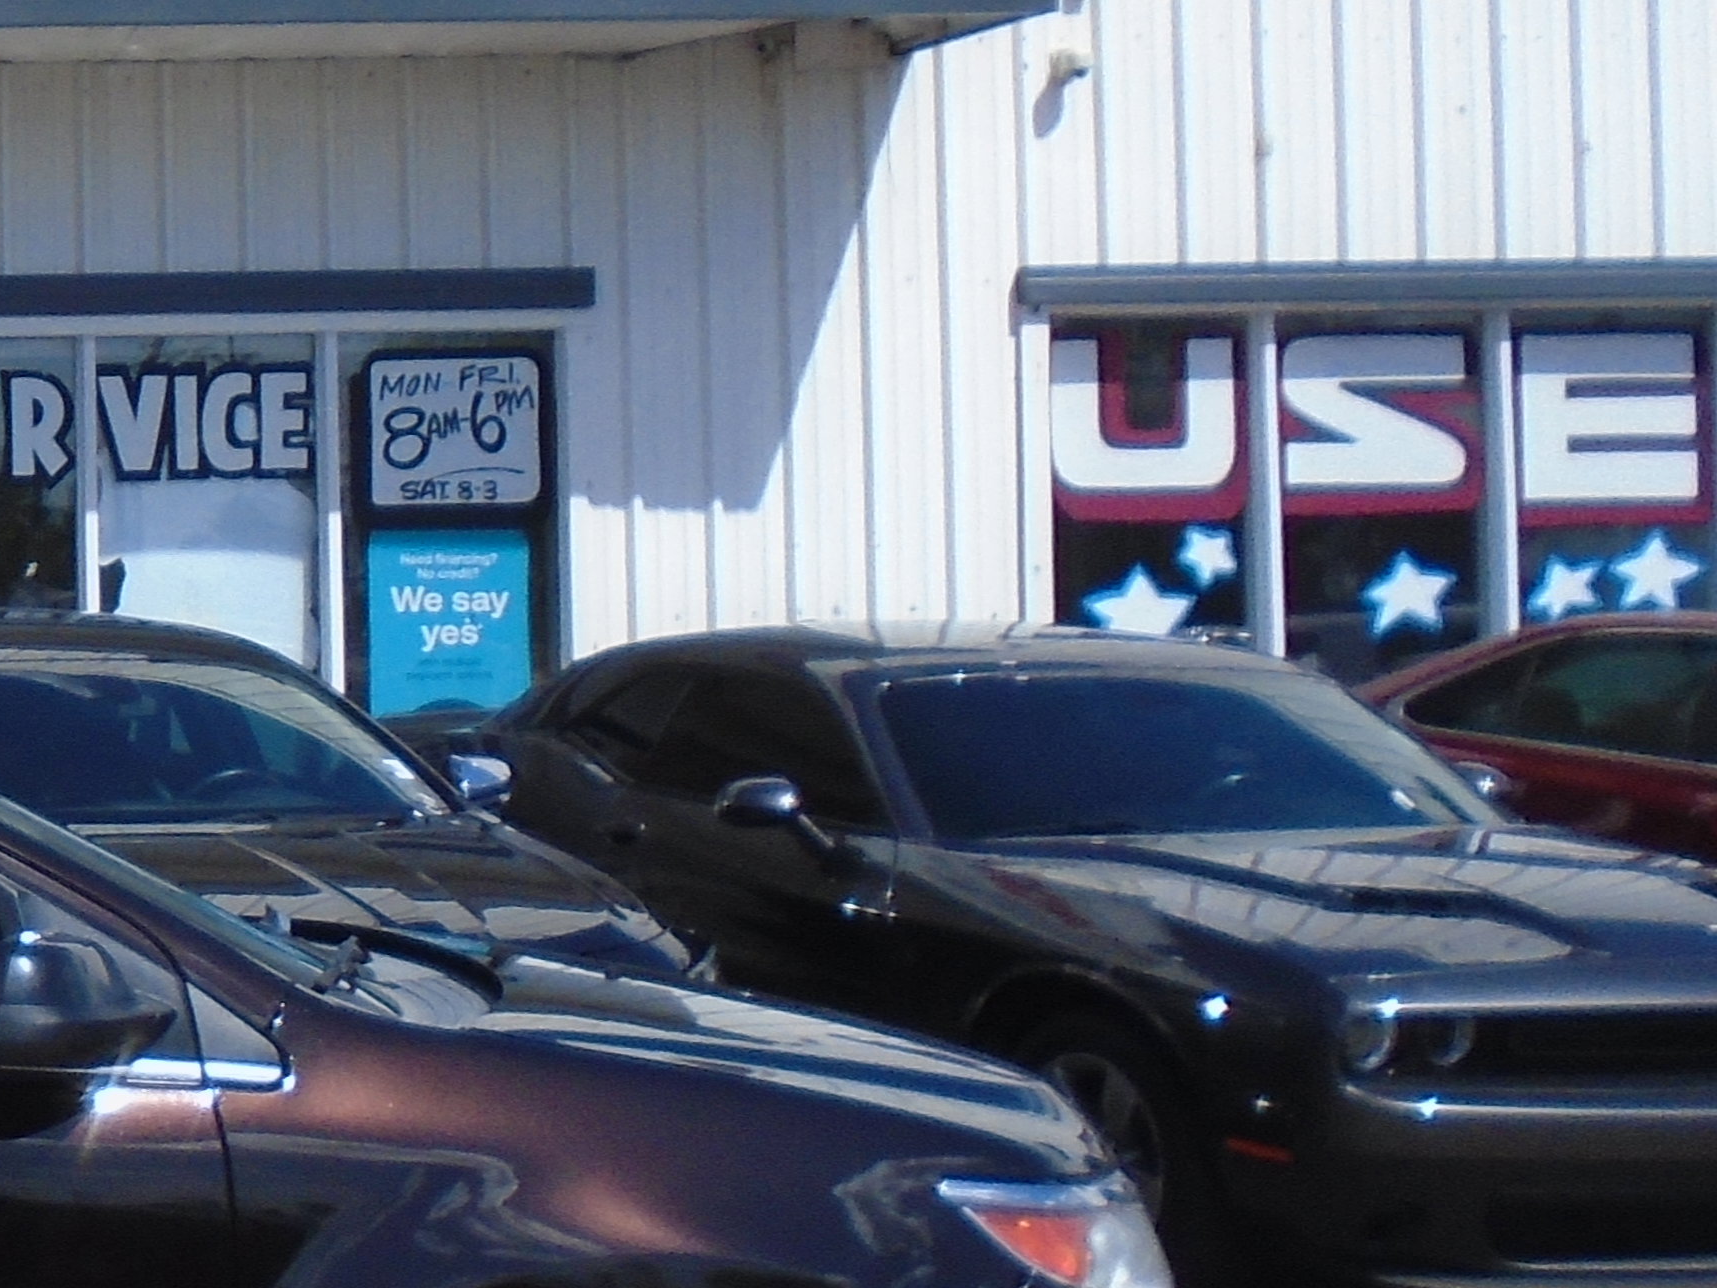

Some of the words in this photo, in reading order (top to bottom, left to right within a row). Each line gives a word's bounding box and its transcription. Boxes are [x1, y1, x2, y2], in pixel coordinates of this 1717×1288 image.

[379, 371, 441, 401] MON
[400, 480, 451, 500] SAT
[390, 585, 444, 613] We
[451, 590, 510, 619] say
